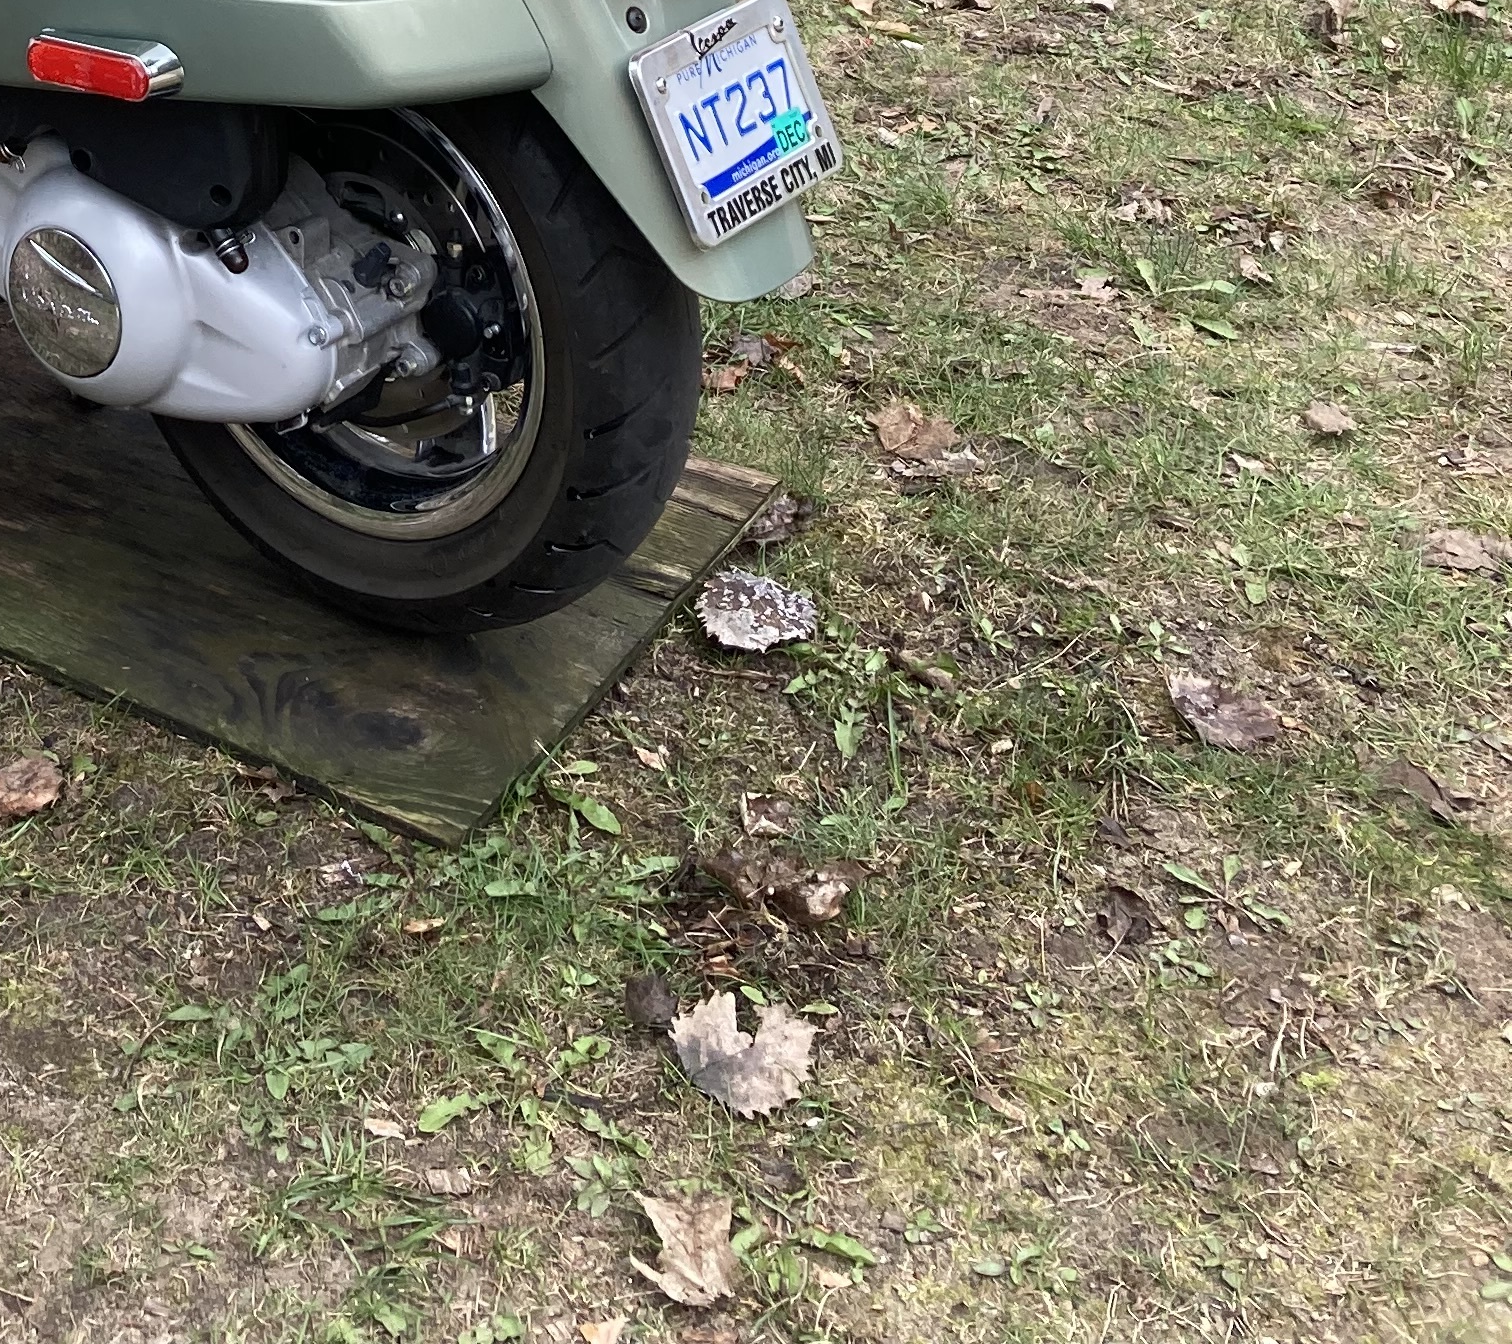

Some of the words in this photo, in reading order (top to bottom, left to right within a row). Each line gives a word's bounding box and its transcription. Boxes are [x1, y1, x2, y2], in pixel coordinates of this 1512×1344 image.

[689, 18, 738, 60] Vespa
[676, 62, 701, 85] PURE
[678, 57, 792, 162] NT237
[776, 119, 806, 153] DEC
[707, 175, 783, 238] TRAVERSE
[780, 154, 819, 193] CITY,
[815, 141, 837, 173] MI
